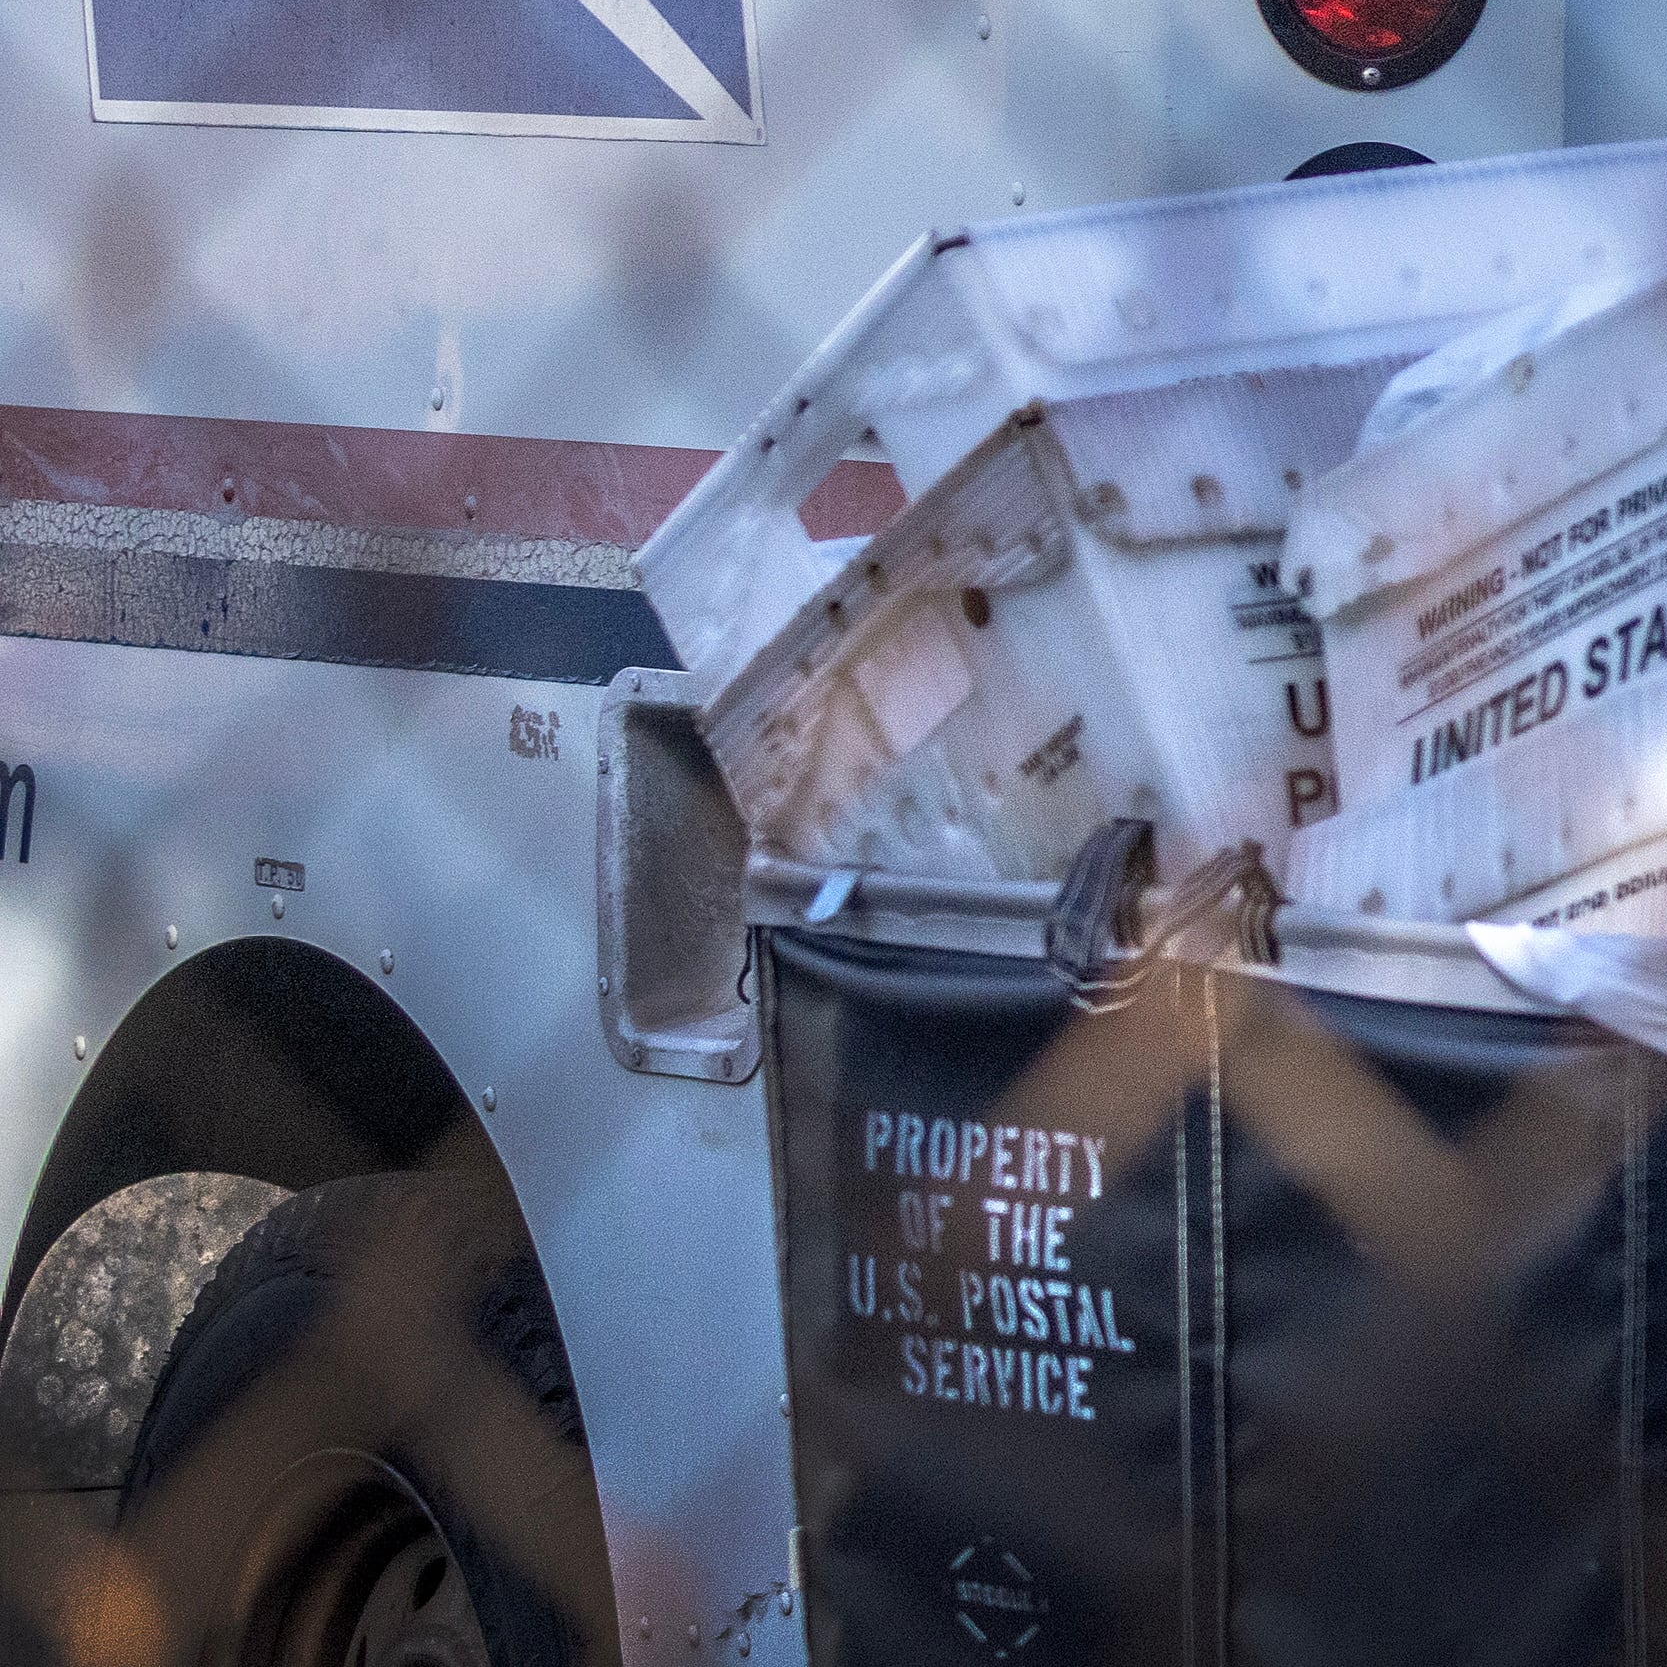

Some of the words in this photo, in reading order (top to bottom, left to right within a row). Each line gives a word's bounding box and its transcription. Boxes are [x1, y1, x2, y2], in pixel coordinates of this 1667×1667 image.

[1521, 532, 1563, 575] NOT
[1568, 507, 1610, 551] FOR
[1408, 659, 1567, 787] UNITED
[864, 1109, 1105, 1199] PROPERTY
[899, 1190, 953, 1255] OF
[982, 1199, 1075, 1272] THE
[850, 1254, 941, 1329] U.S.
[960, 1269, 1137, 1353] POSTAL
[901, 1336, 1097, 1422] SERVICE
